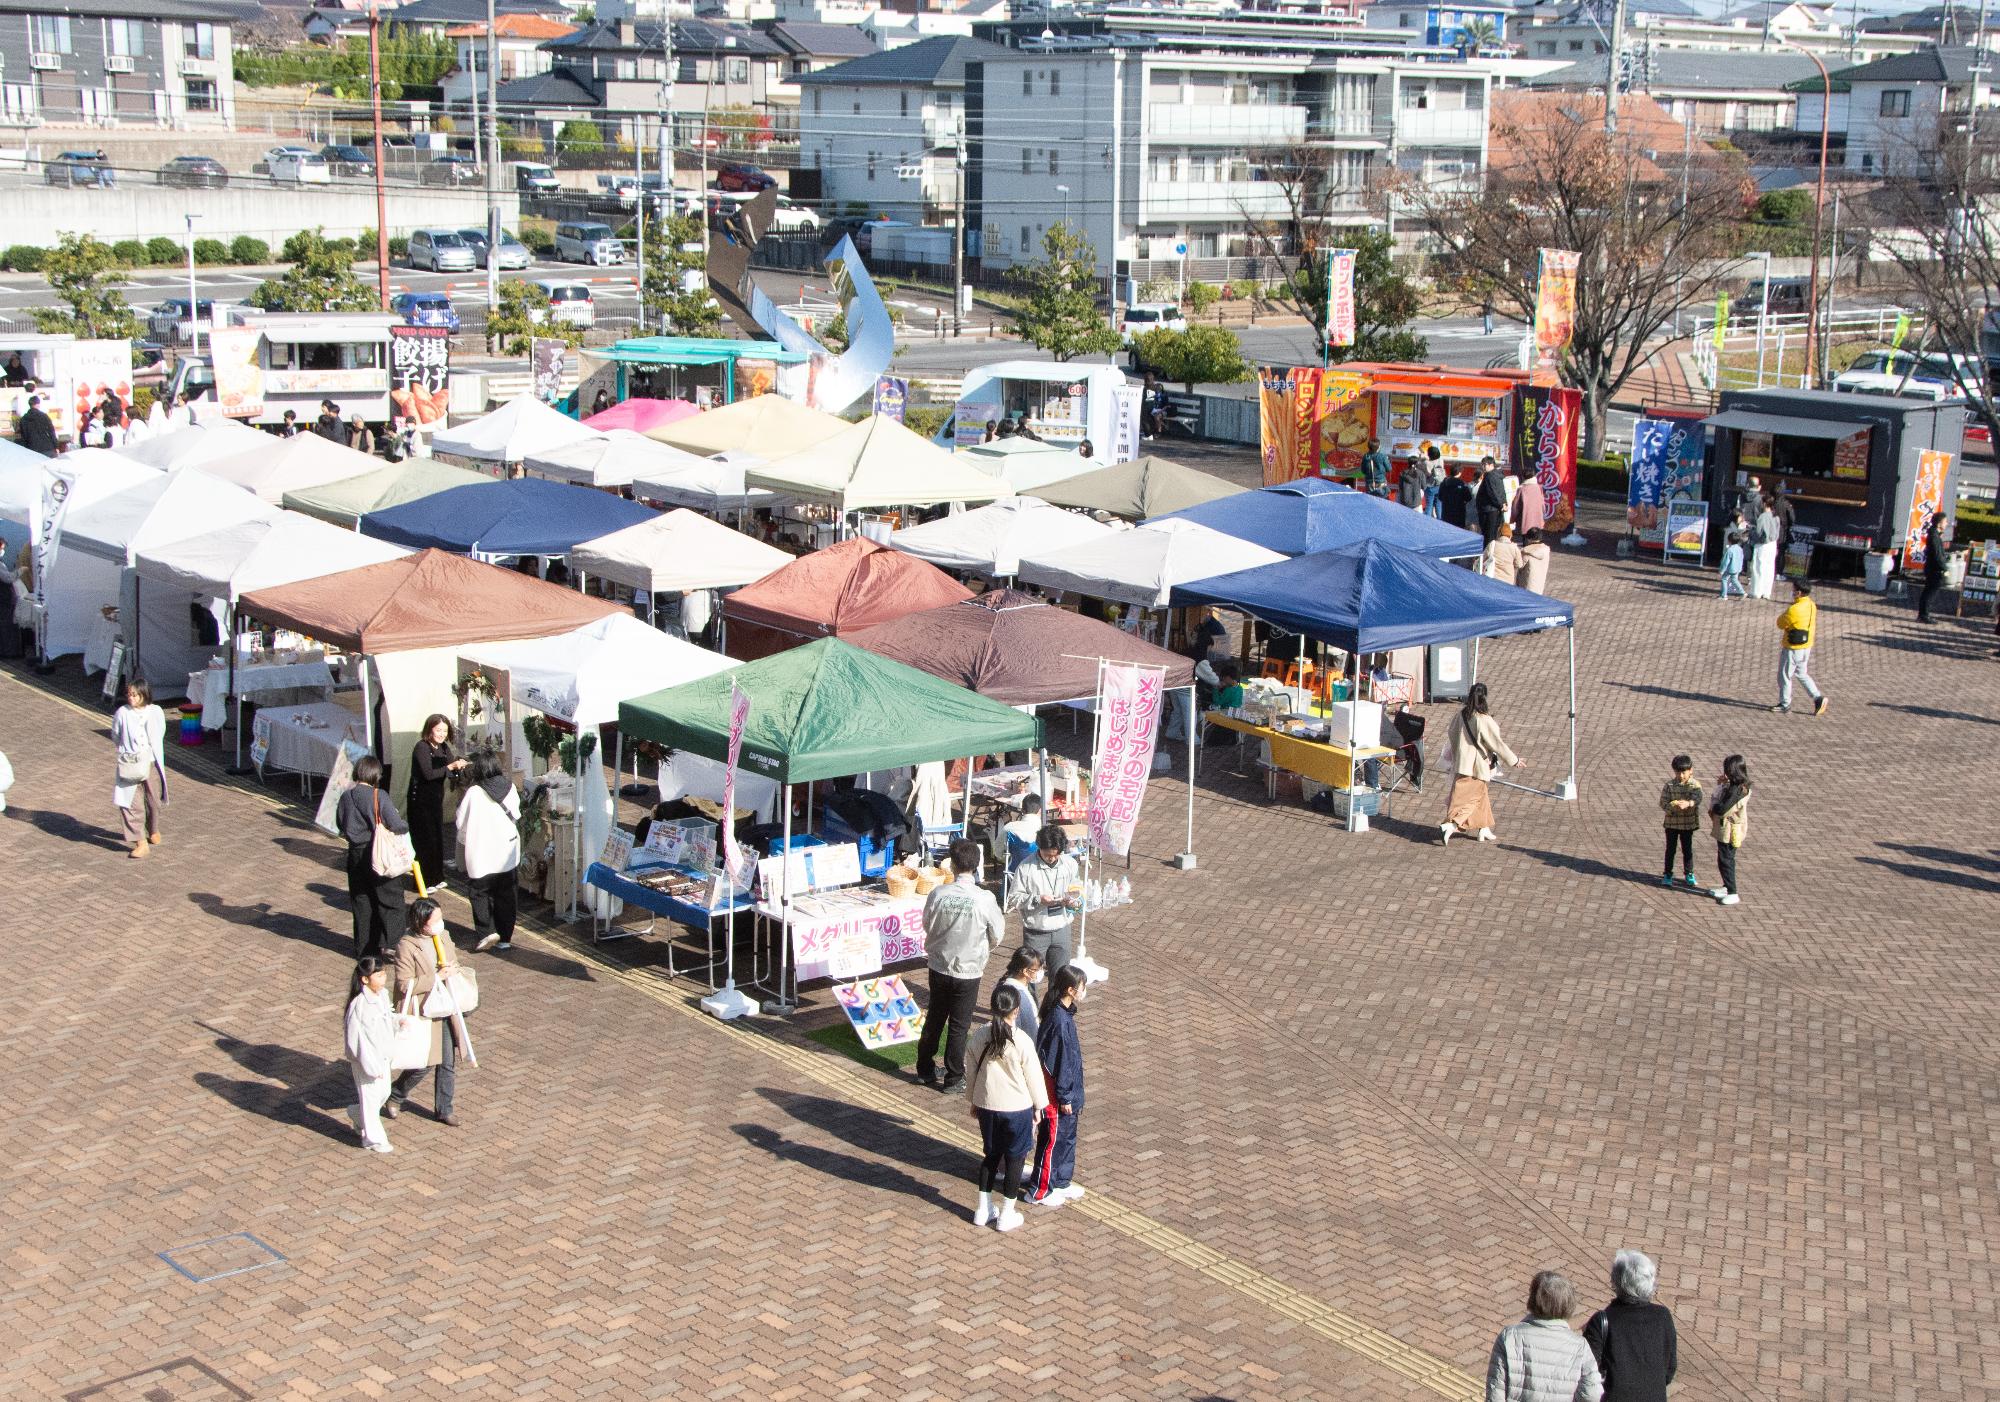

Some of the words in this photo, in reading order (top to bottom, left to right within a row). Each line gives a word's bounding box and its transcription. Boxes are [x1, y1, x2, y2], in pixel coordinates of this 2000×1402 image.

[418, 327, 448, 337] GYOZA
[1536, 400, 1566, 520] からあげ
[1635, 427, 1662, 503] たい焼き
[1108, 675, 1159, 823] メグリアの宅配
